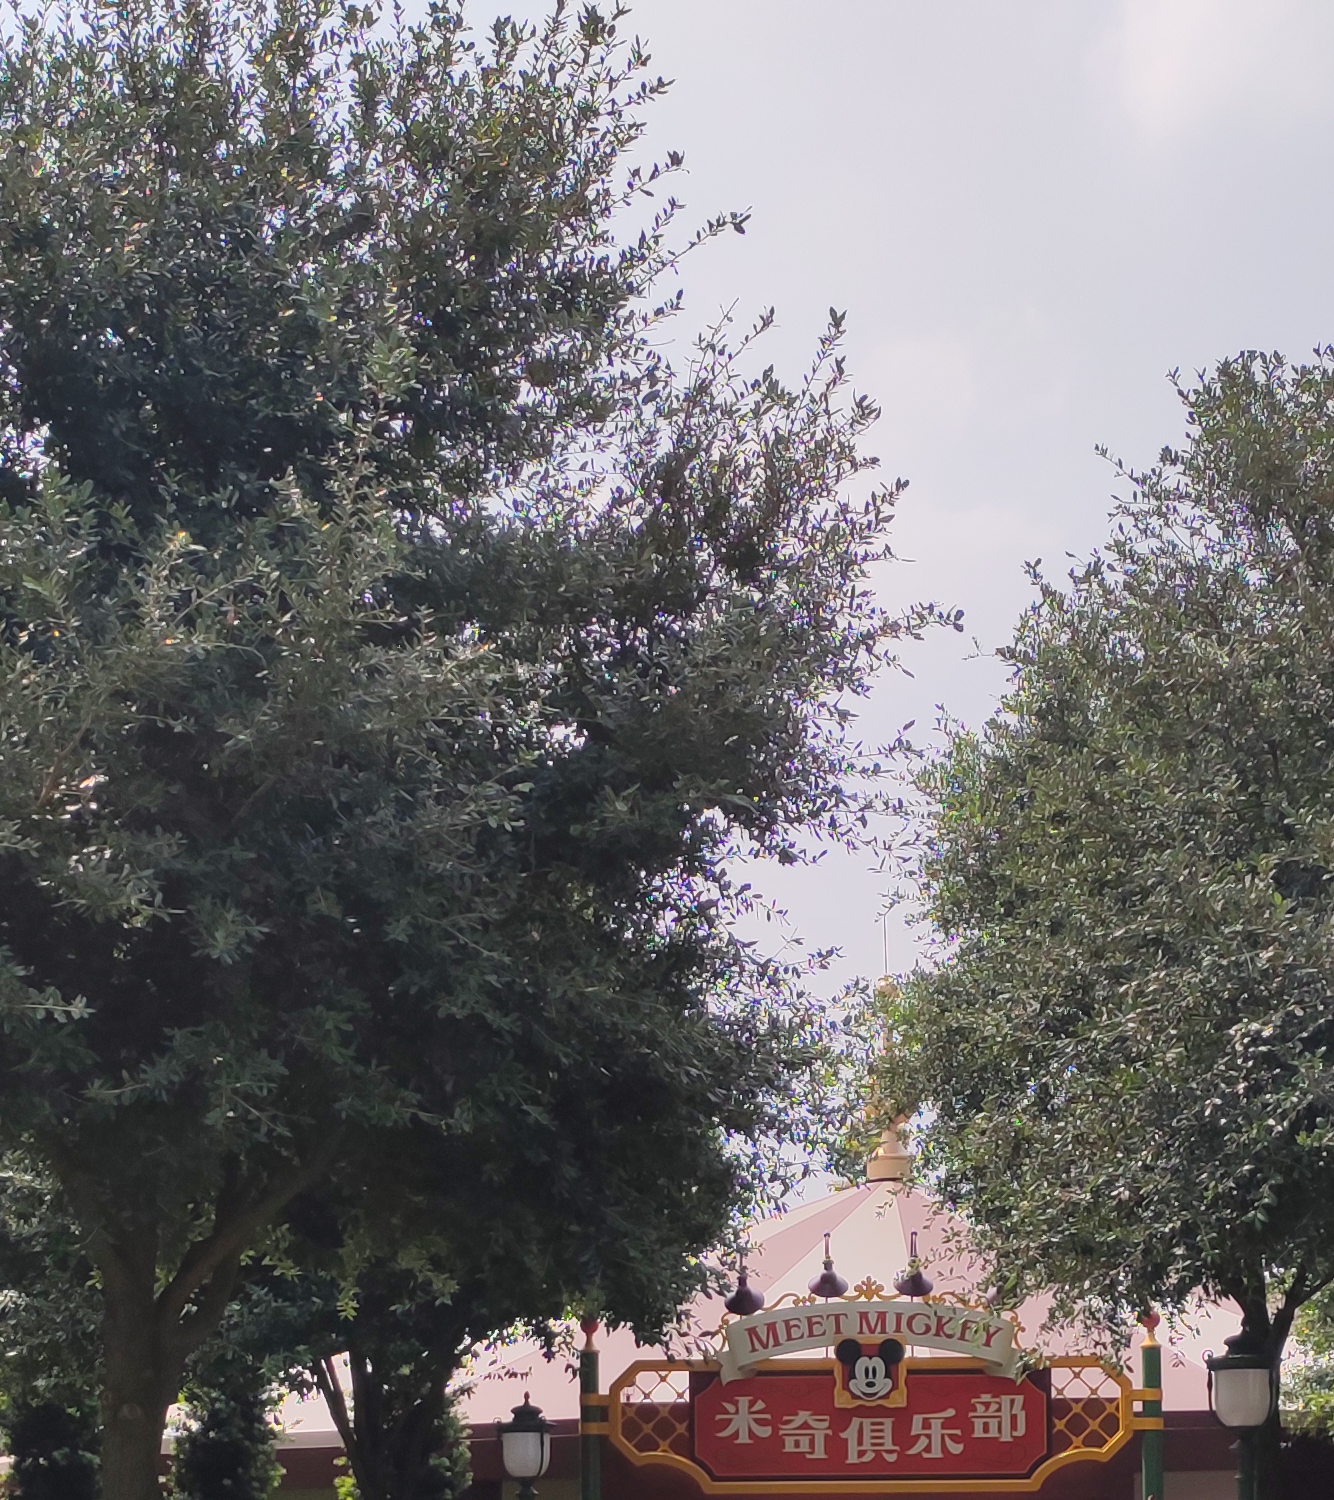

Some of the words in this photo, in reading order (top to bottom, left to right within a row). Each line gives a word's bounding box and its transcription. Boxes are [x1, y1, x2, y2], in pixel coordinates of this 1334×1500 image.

[745, 1312, 848, 1353] MEET
[857, 1310, 1004, 1348] MICKEY
[715, 1394, 1027, 1464] 米奇俱乐部
